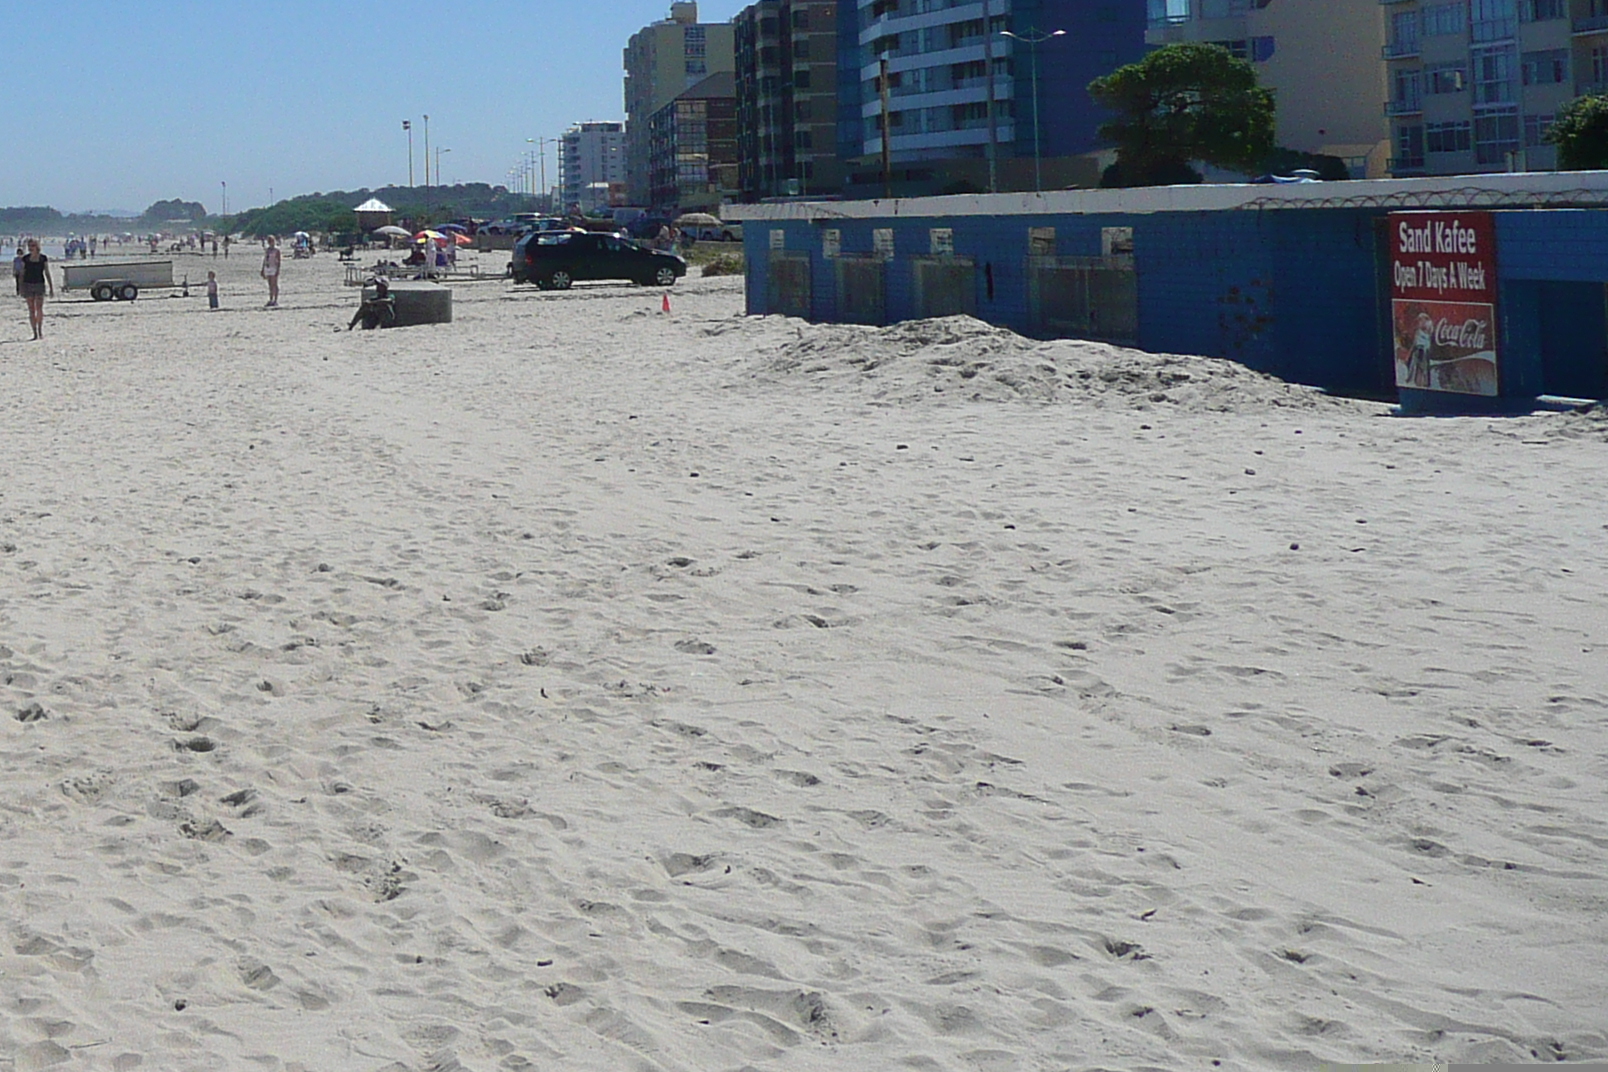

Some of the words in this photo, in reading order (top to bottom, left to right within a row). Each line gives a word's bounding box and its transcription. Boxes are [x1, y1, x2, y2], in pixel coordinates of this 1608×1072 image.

[1399, 220, 1431, 253] Sand
[1435, 219, 1476, 254] Kafee
[1394, 260, 1416, 294] Open
[1417, 261, 1424, 288] 7
[1425, 261, 1447, 295] Days
[1450, 261, 1457, 289] A
[1457, 261, 1486, 290] Week
